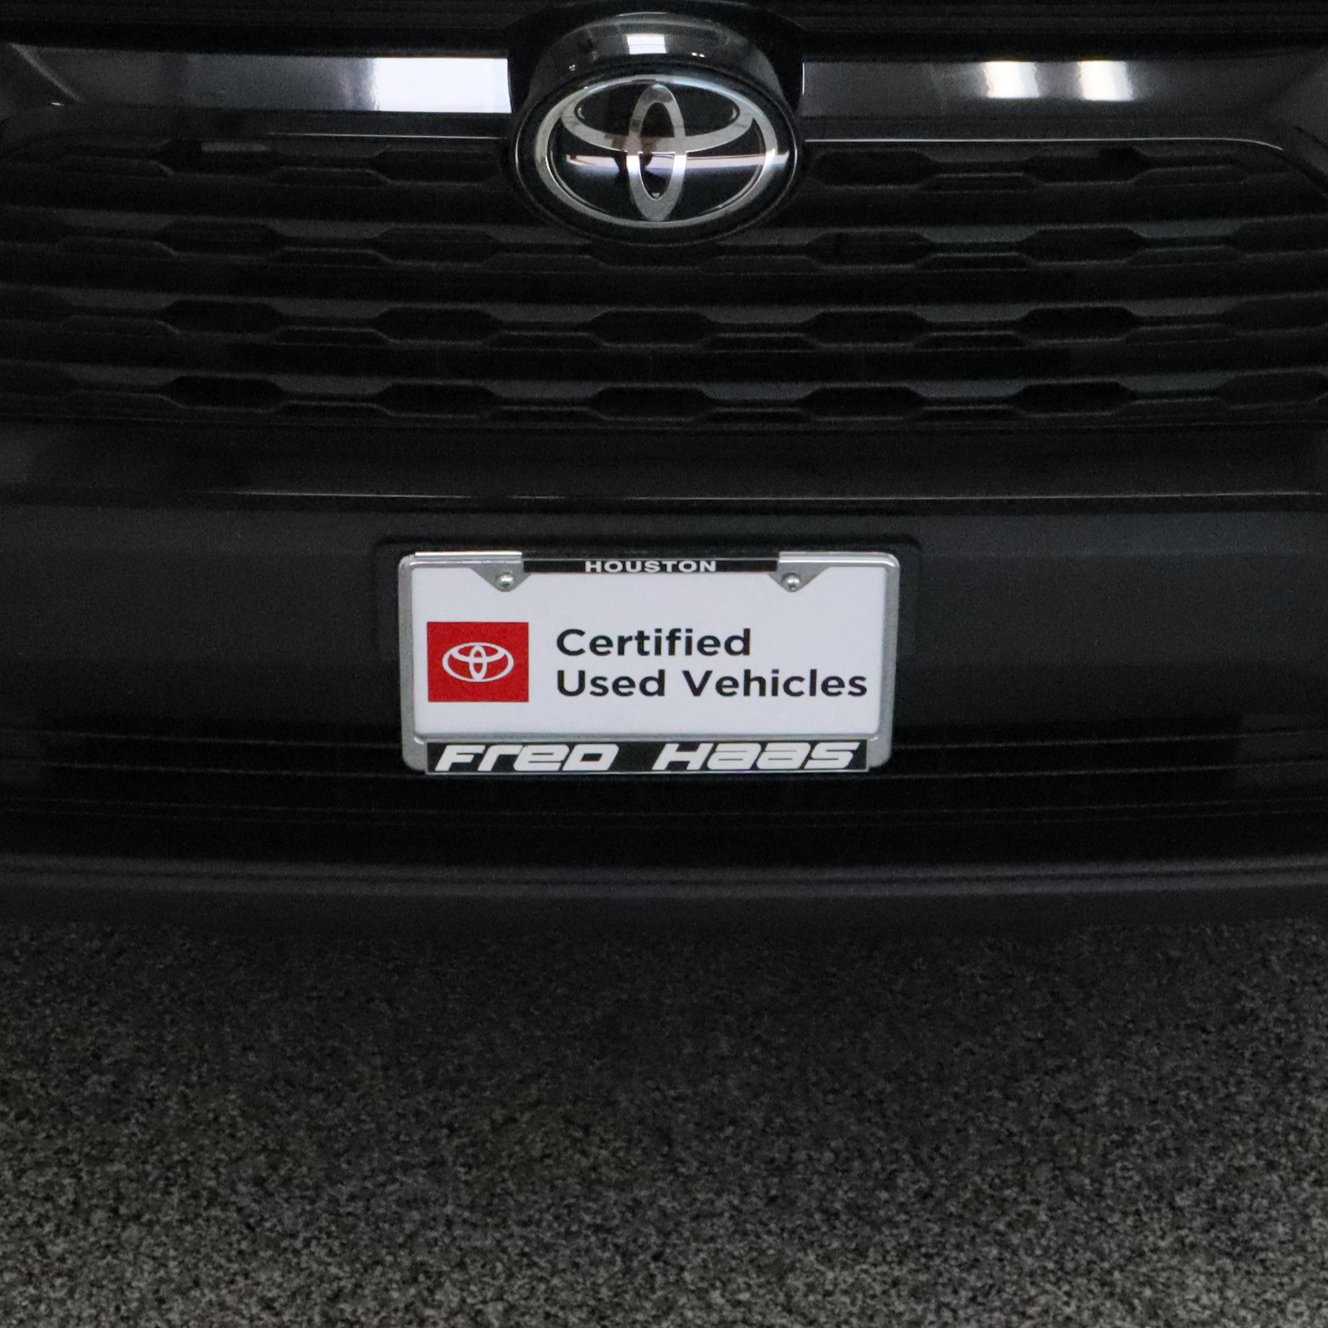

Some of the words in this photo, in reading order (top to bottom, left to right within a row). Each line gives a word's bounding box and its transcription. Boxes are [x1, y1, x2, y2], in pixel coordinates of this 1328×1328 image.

[584, 560, 717, 573] HOUSTON
[556, 627, 751, 657] Certified
[556, 668, 666, 698] Used
[682, 668, 868, 698] Vehicles
